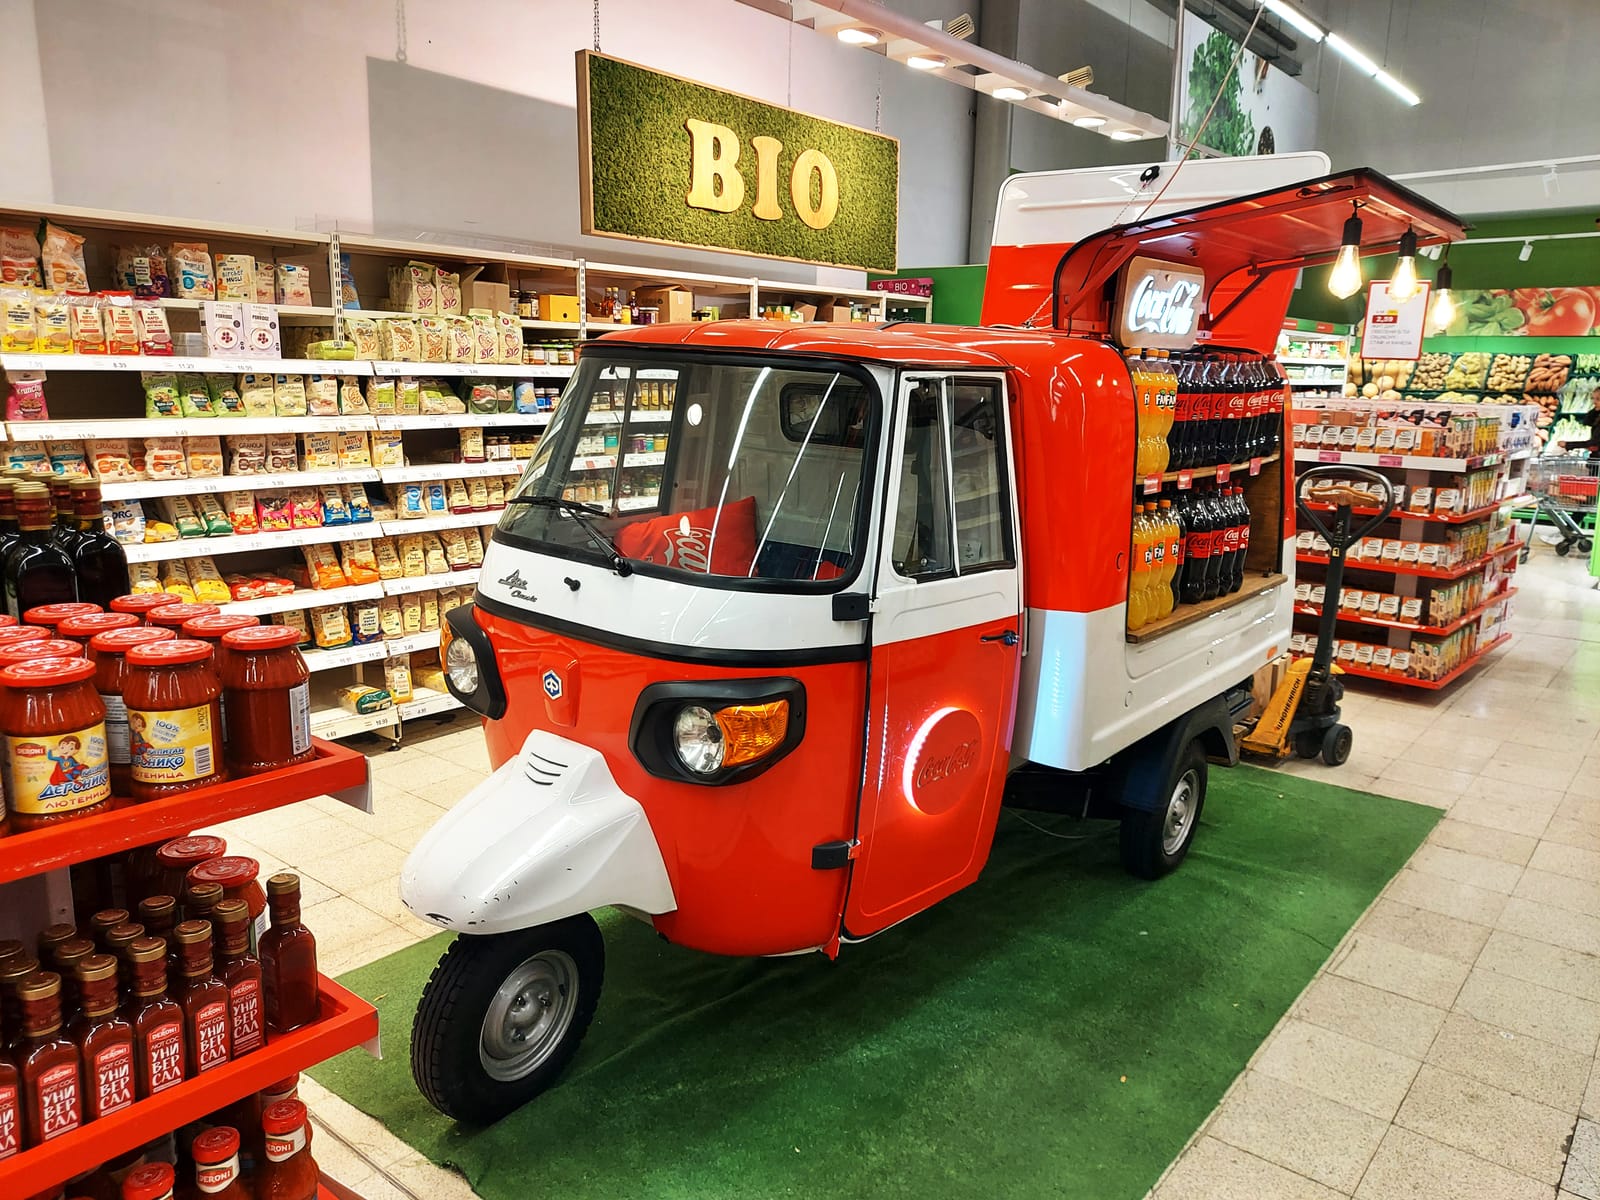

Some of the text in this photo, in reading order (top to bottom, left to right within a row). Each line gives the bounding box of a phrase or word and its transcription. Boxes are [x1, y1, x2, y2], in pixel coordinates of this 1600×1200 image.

[685, 118, 839, 230] BIO
[1128, 275, 1200, 335] Coca-Cola
[428, 347, 443, 358] BIO
[456, 346, 470, 357] BIO
[480, 348, 494, 359] BIO
[505, 347, 519, 358] BIO
[155, 720, 180, 732] 100%
[233, 998, 257, 1016] УНИ
[234, 1009, 258, 1028] ВЕР
[200, 1021, 225, 1040] УНИ
[234, 1020, 259, 1038] САЛ
[151, 1042, 179, 1062] УНИ
[200, 1034, 225, 1053] ВЕР
[200, 1045, 226, 1064] САЛ
[99, 1063, 129, 1084] УНИ
[152, 1055, 179, 1074] ВЕР
[152, 1067, 181, 1086] САЛ
[42, 1084, 75, 1107] УНИ
[99, 1076, 129, 1097] ВЕР
[44, 1098, 76, 1120] ВЕР
[99, 1089, 131, 1110] САЛ
[44, 1110, 77, 1133] САЛ
